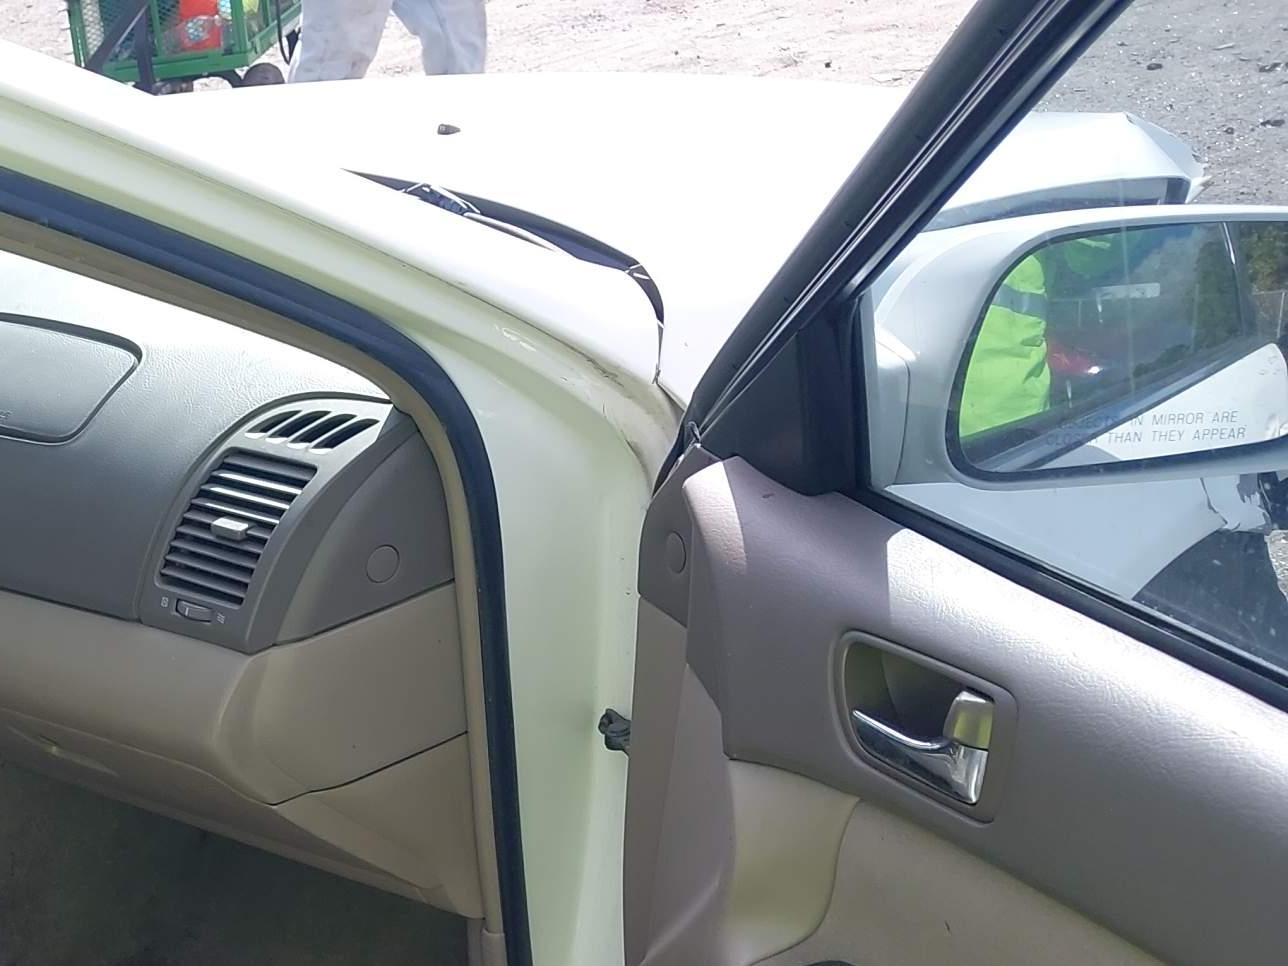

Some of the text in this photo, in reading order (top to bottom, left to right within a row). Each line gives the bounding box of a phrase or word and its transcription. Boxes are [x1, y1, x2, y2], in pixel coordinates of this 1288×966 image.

[1151, 413, 1204, 426] MIRROR
[1212, 411, 1239, 424] ARE
[1108, 431, 1143, 444] THAN
[1152, 430, 1185, 442] THEY
[1192, 427, 1246, 441] APPEAR
